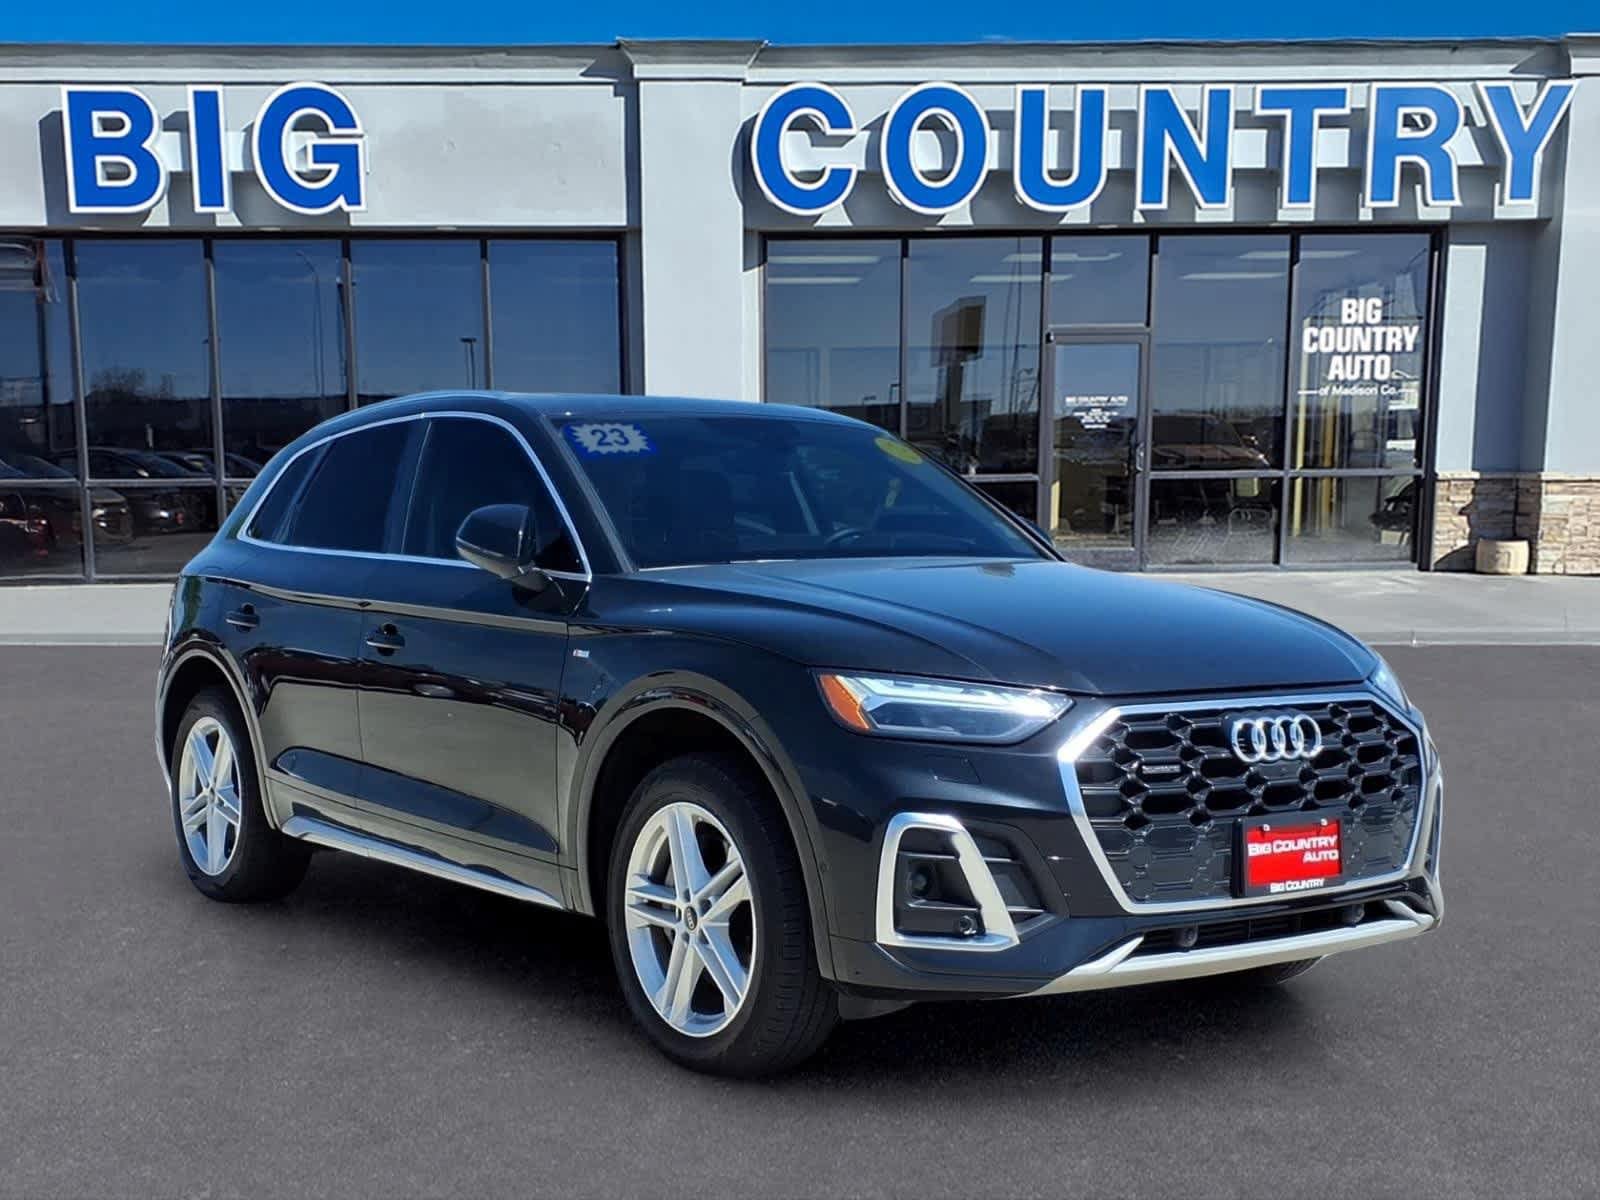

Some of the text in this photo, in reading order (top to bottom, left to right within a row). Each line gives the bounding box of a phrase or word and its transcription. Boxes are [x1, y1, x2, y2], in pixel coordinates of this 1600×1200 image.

[61, 81, 1576, 216] BIG COUNTRY
[1341, 297, 1382, 325] BIG
[1303, 325, 1419, 353] COUNTRY
[1327, 354, 1391, 381] AUTO
[1319, 385, 1329, 396] of
[1331, 384, 1378, 396] Madison
[591, 428, 630, 446] 23
[1273, 836, 1337, 853] COUNTRY
[1303, 849, 1339, 863] AUTO
[1286, 878, 1324, 890] COUNTRY
